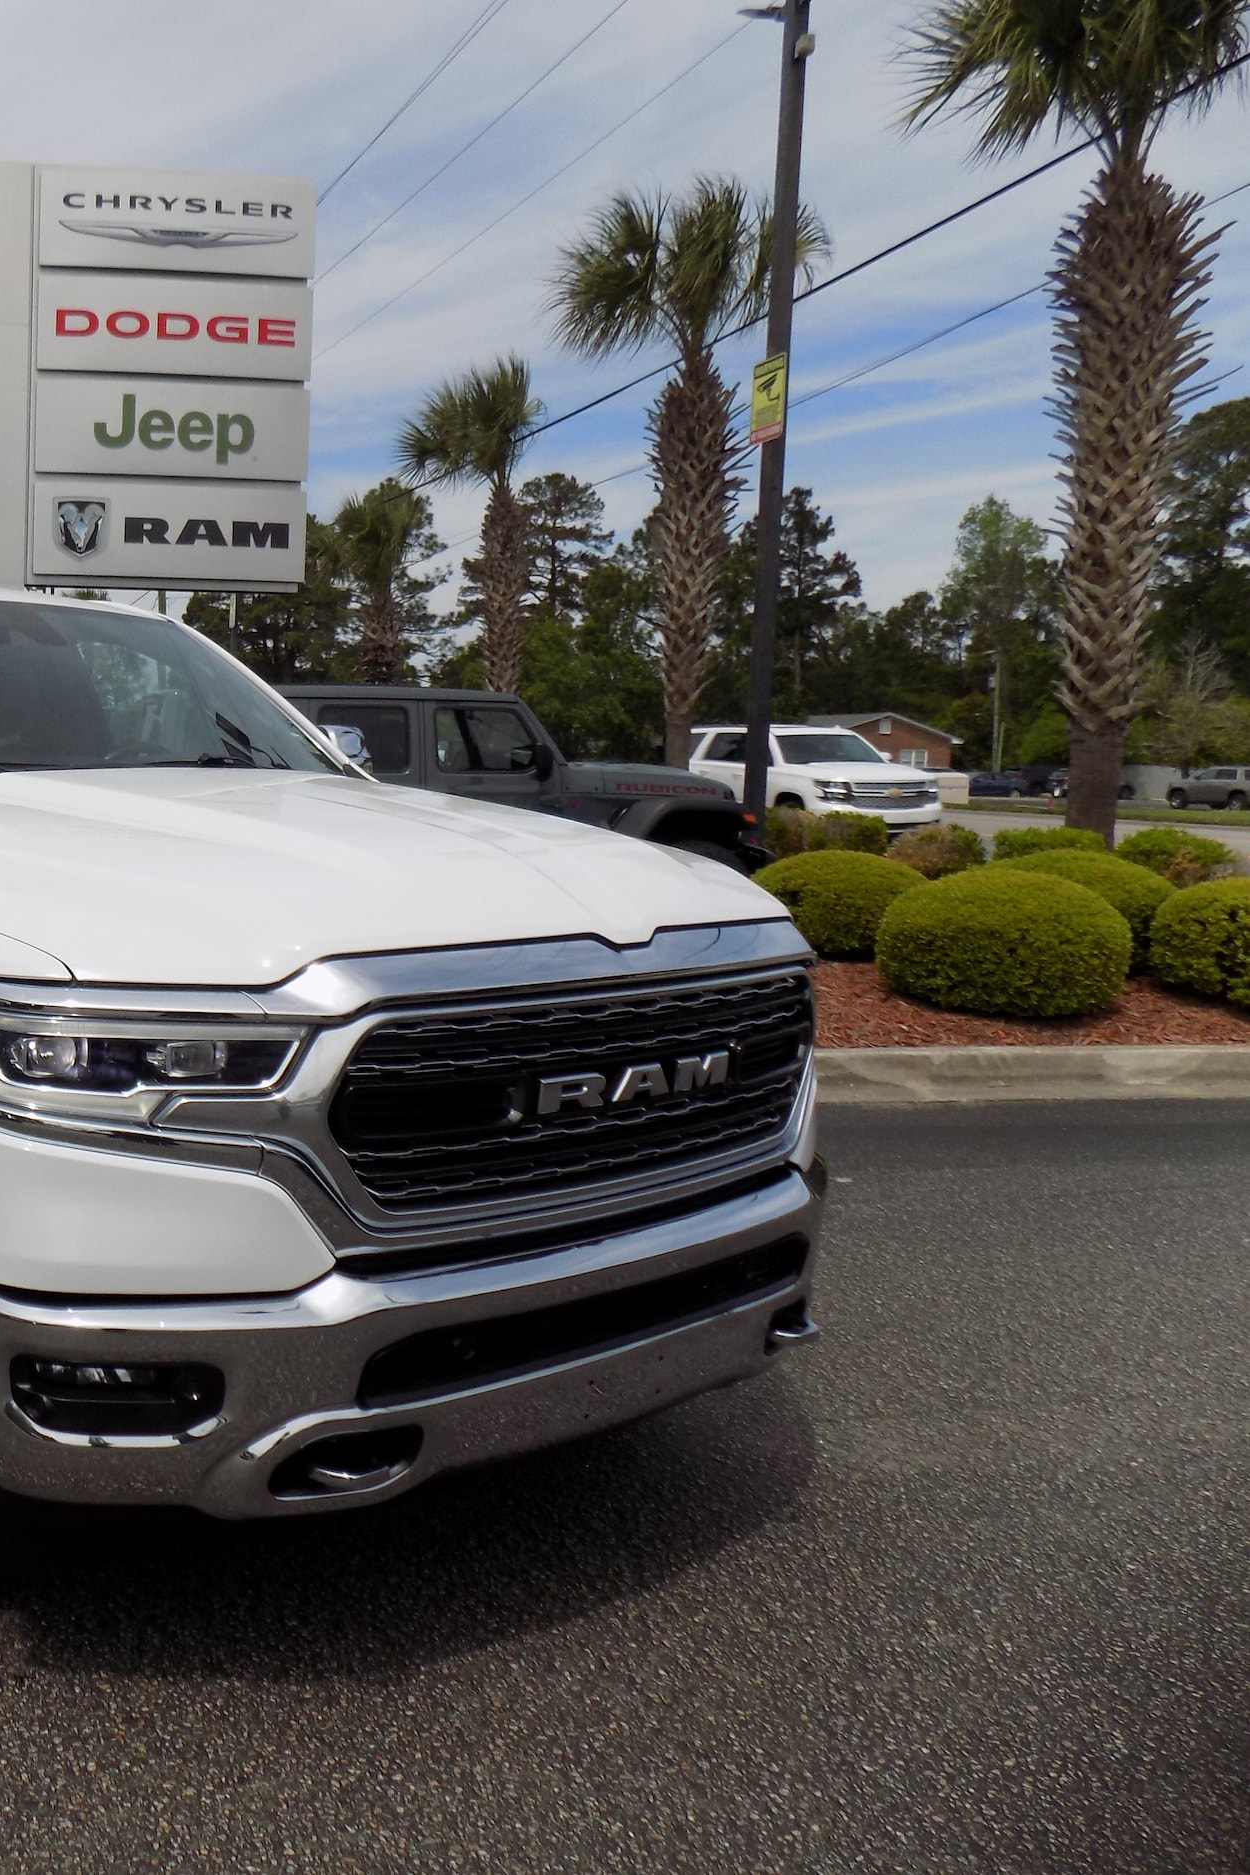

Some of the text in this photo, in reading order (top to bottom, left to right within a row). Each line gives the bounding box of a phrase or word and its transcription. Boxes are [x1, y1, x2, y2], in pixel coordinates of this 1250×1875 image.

[62, 193, 293, 220] CHRYSLER
[55, 308, 296, 347] DODGE
[93, 393, 255, 464] Jeep
[123, 516, 290, 549] RAM
[615, 782, 717, 796] RUBICON
[537, 1049, 729, 1115] RAM
